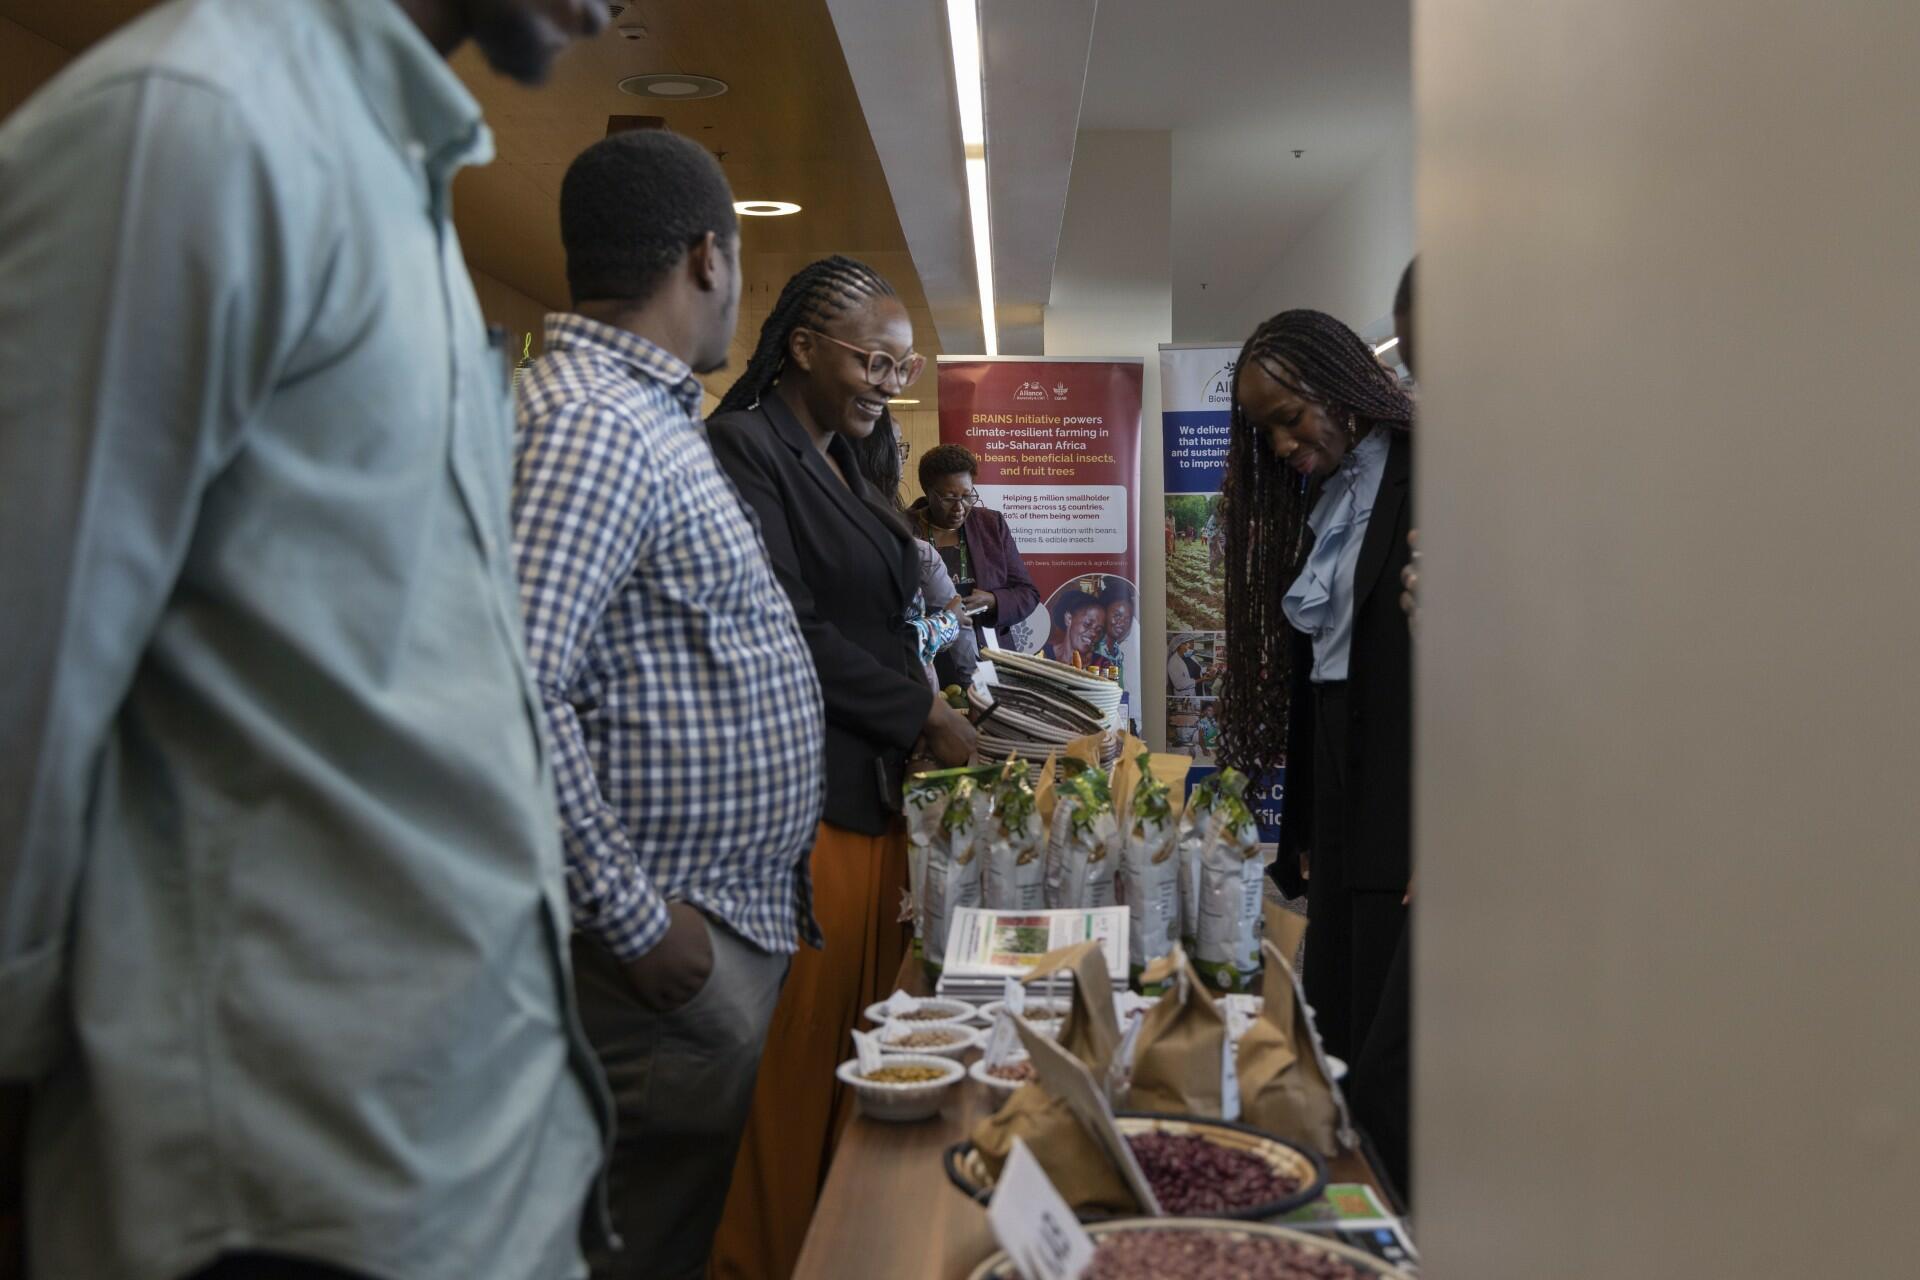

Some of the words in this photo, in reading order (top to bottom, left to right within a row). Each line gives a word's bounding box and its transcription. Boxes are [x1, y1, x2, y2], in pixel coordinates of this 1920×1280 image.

[972, 414, 1012, 424] BRAINS
[1015, 414, 1061, 424] Initiative
[1063, 416, 1103, 426] powers
[965, 427, 1053, 437] climate-resilient
[1055, 428, 1096, 439] farming
[1099, 428, 1109, 437] in
[1180, 426, 1195, 434] We
[1197, 426, 1230, 434] deliver
[986, 441, 1053, 450] sub-Saharan
[1055, 441, 1087, 450] Africa
[1179, 438, 1198, 446] that
[1172, 448, 1188, 457] and
[984, 454, 1019, 464] beans,
[1022, 454, 1074, 463] beneficial
[1076, 454, 1116, 464] insects,
[1180, 460, 1190, 468] to
[1000, 466, 1020, 476] and
[1023, 466, 1045, 476] fruit
[1048, 467, 1075, 476] trees
[1002, 494, 1032, 503] Helping
[1050, 512, 1070, 521] being
